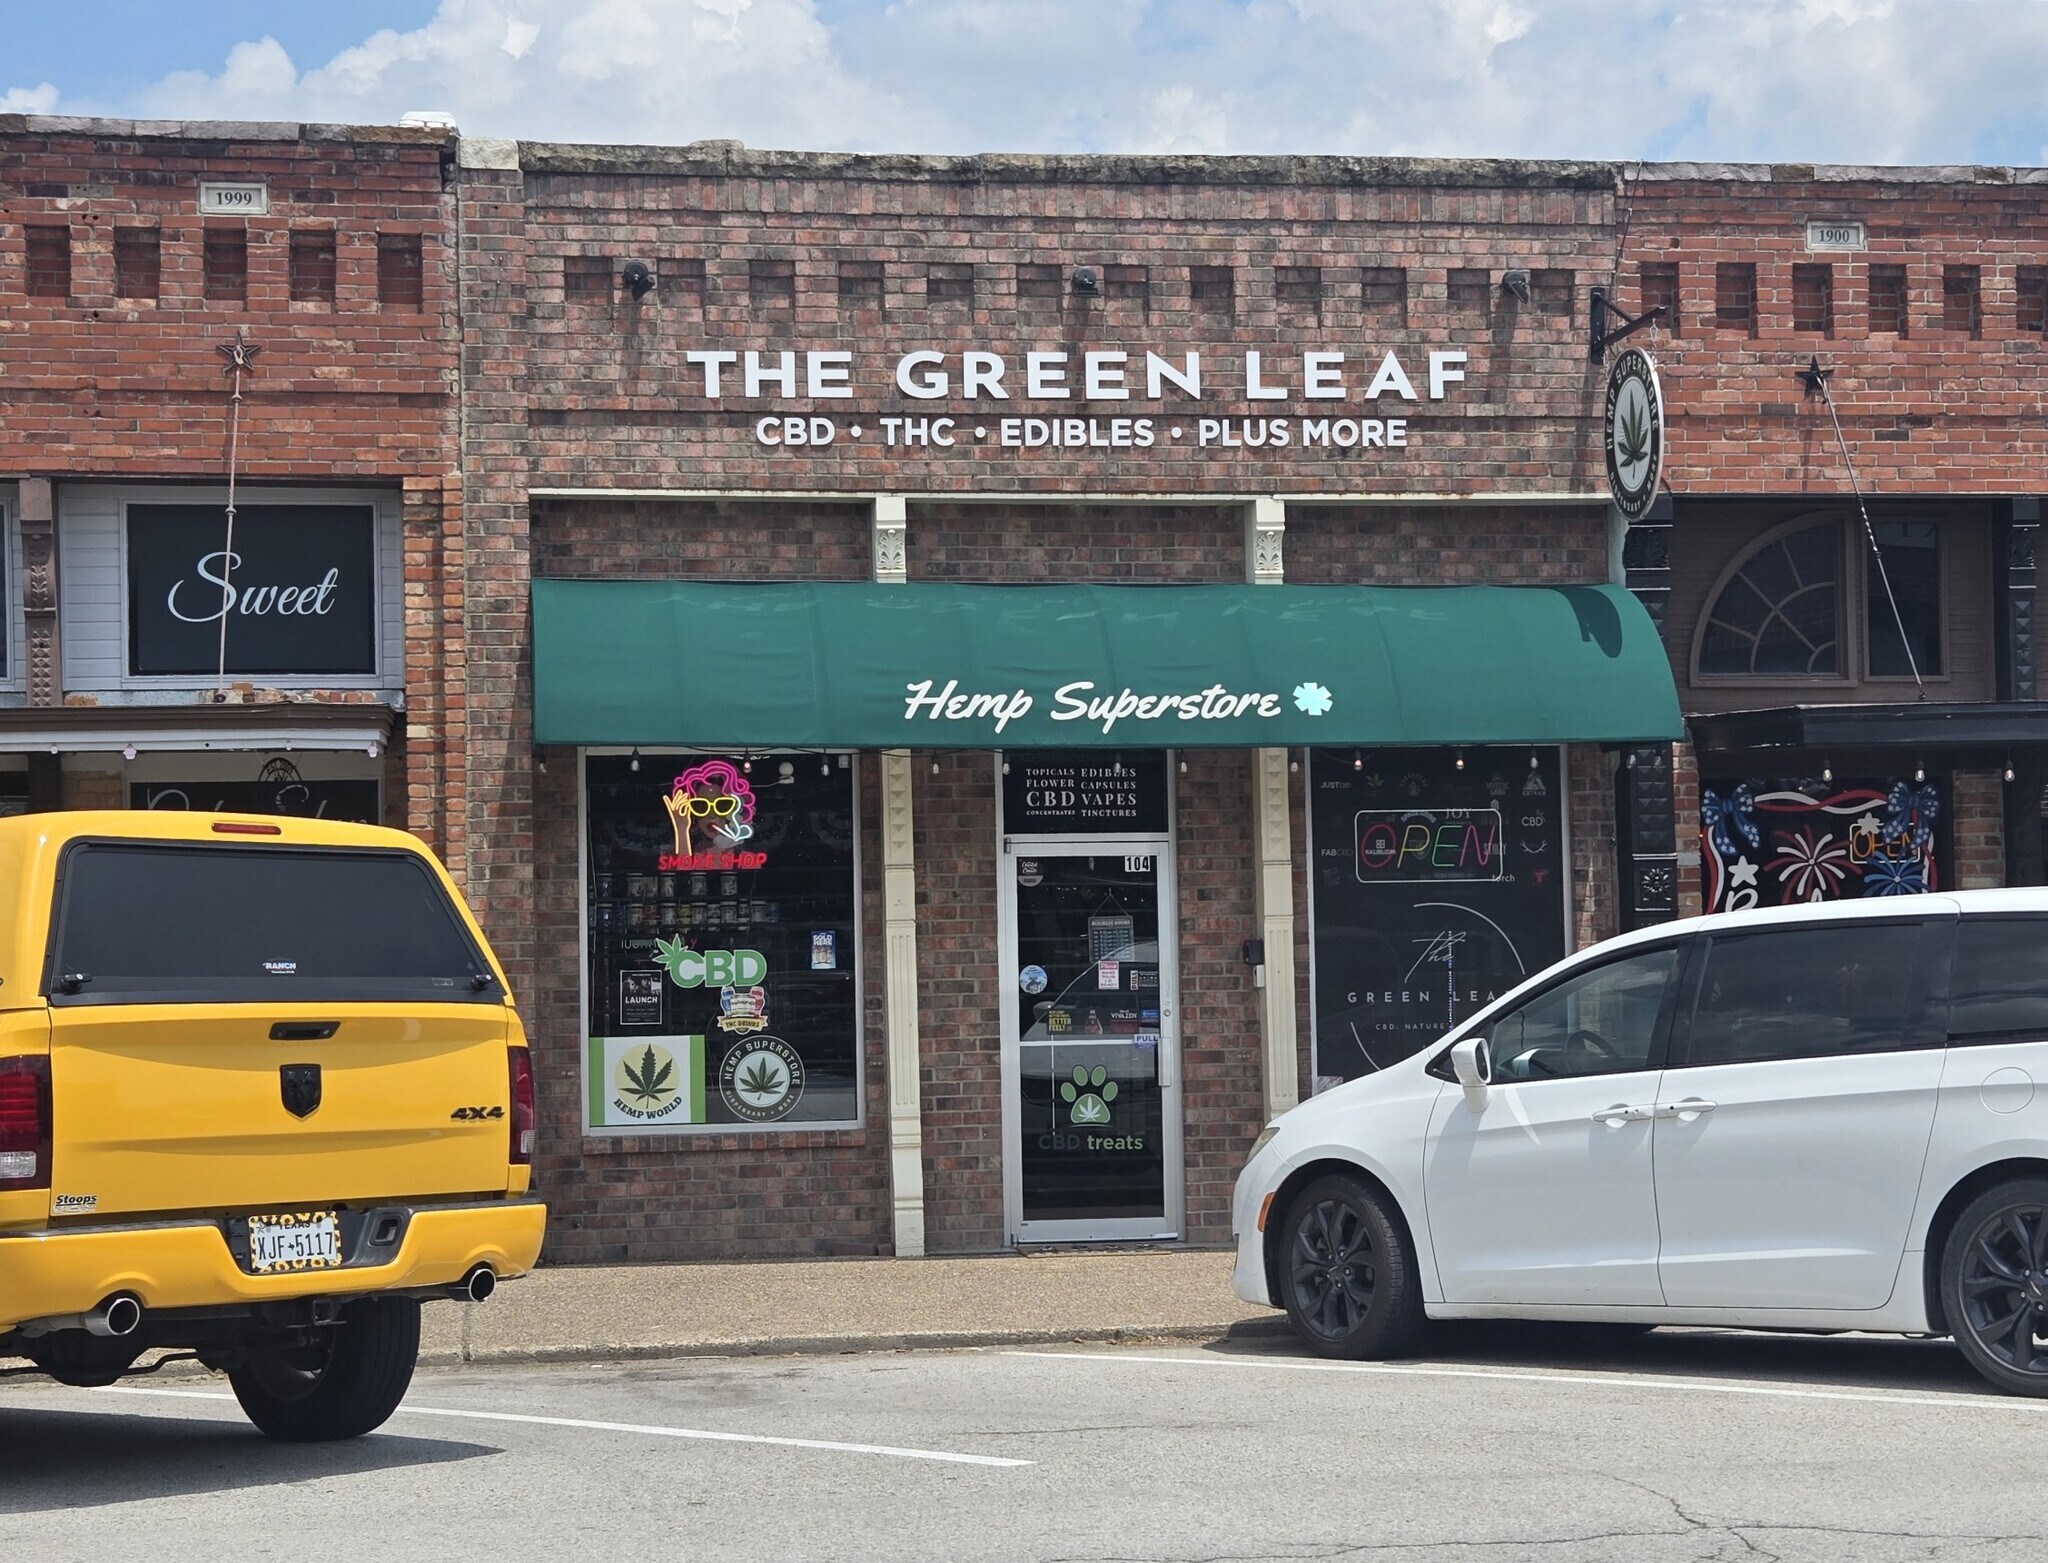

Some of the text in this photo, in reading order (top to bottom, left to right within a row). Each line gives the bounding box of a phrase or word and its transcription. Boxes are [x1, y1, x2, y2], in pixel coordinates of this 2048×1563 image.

[216, 191, 253, 206] 1999
[1819, 229, 1850, 243] 1900
[687, 349, 1468, 400] THE GREEN LEAF
[1606, 354, 1659, 450] HEMP SUPERSTORE
[756, 416, 1408, 447] CBD THC EDIBLES PLUS MORE
[167, 551, 339, 622] Sweet
[904, 679, 1282, 734] Hemp Superstore
[1025, 768, 1075, 776] TOPICALS
[1026, 779, 1075, 788] FLOWER
[1081, 781, 1137, 789] CAPSULES
[1026, 791, 1075, 807] CBD
[1081, 793, 1137, 806] VAPES
[1081, 809, 1137, 817] TINCTURES
[1521, 816, 1544, 827] CBD
[1360, 822, 1497, 869] OPEN
[658, 851, 767, 870] SMOKE SHOP
[1125, 856, 1150, 871] 104
[262, 962, 297, 970] RANCH
[669, 949, 768, 989] CBD
[625, 996, 658, 1004] LAUNCH
[1347, 990, 1510, 1004] GREEN LEA
[724, 1040, 800, 1085] HEMP SUPERSTORE
[450, 1106, 506, 1120] 4X4
[613, 1096, 683, 1119] HEMP WORLD
[1039, 1134, 1144, 1150] CBD treats
[55, 1194, 98, 1206] Stoops
[280, 1222, 311, 1230] TEXAS
